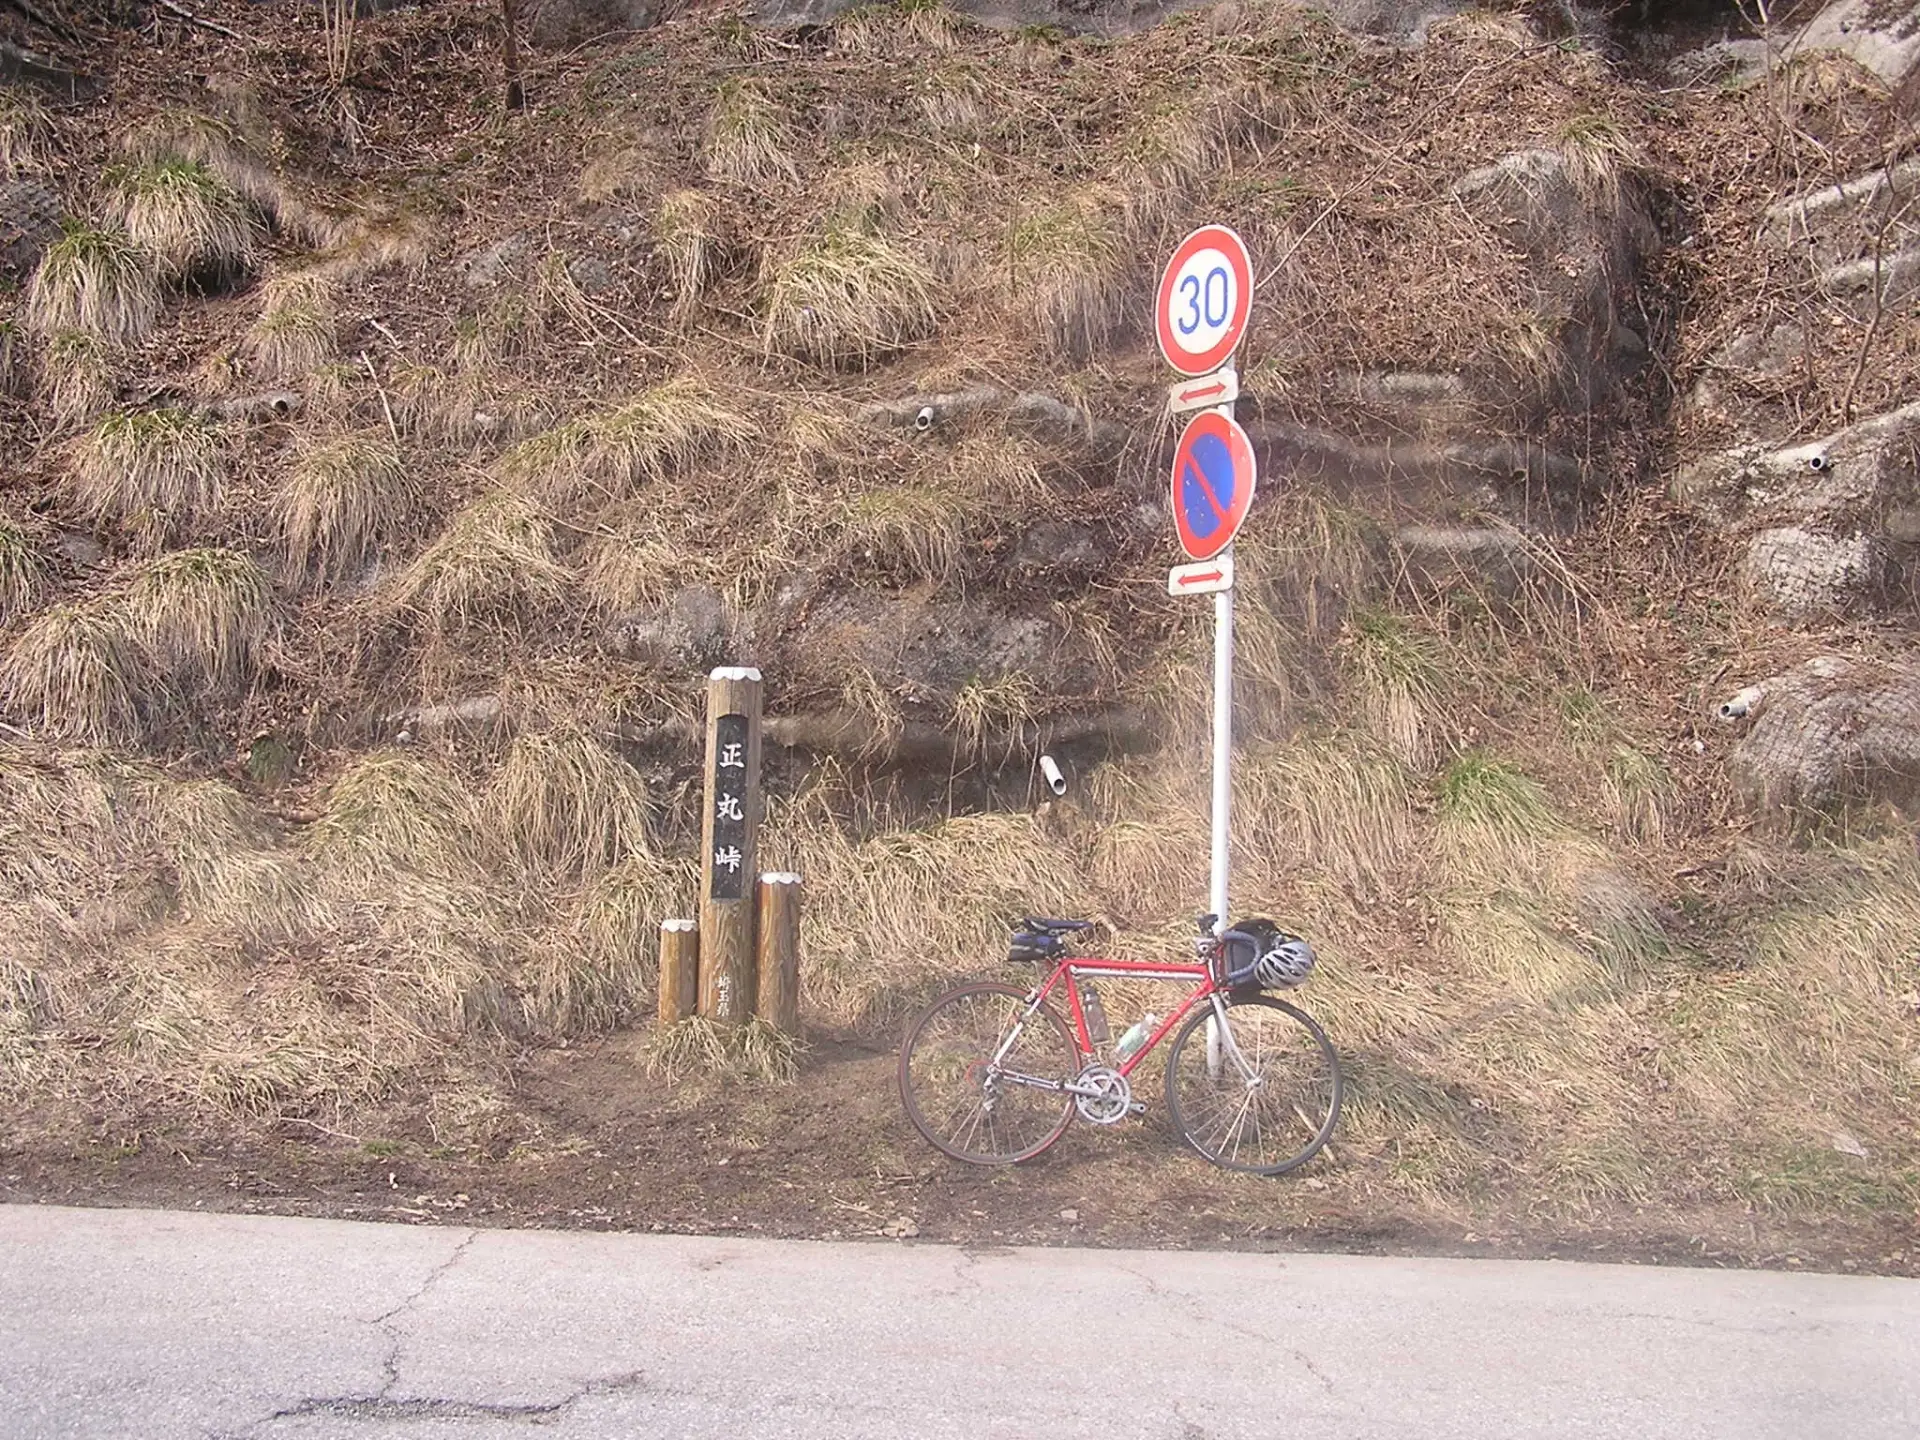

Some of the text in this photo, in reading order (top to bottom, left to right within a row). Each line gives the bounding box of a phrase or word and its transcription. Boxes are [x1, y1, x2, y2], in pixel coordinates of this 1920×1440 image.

[1178, 266, 1228, 335] 30
[715, 743, 744, 873] 正丸峠
